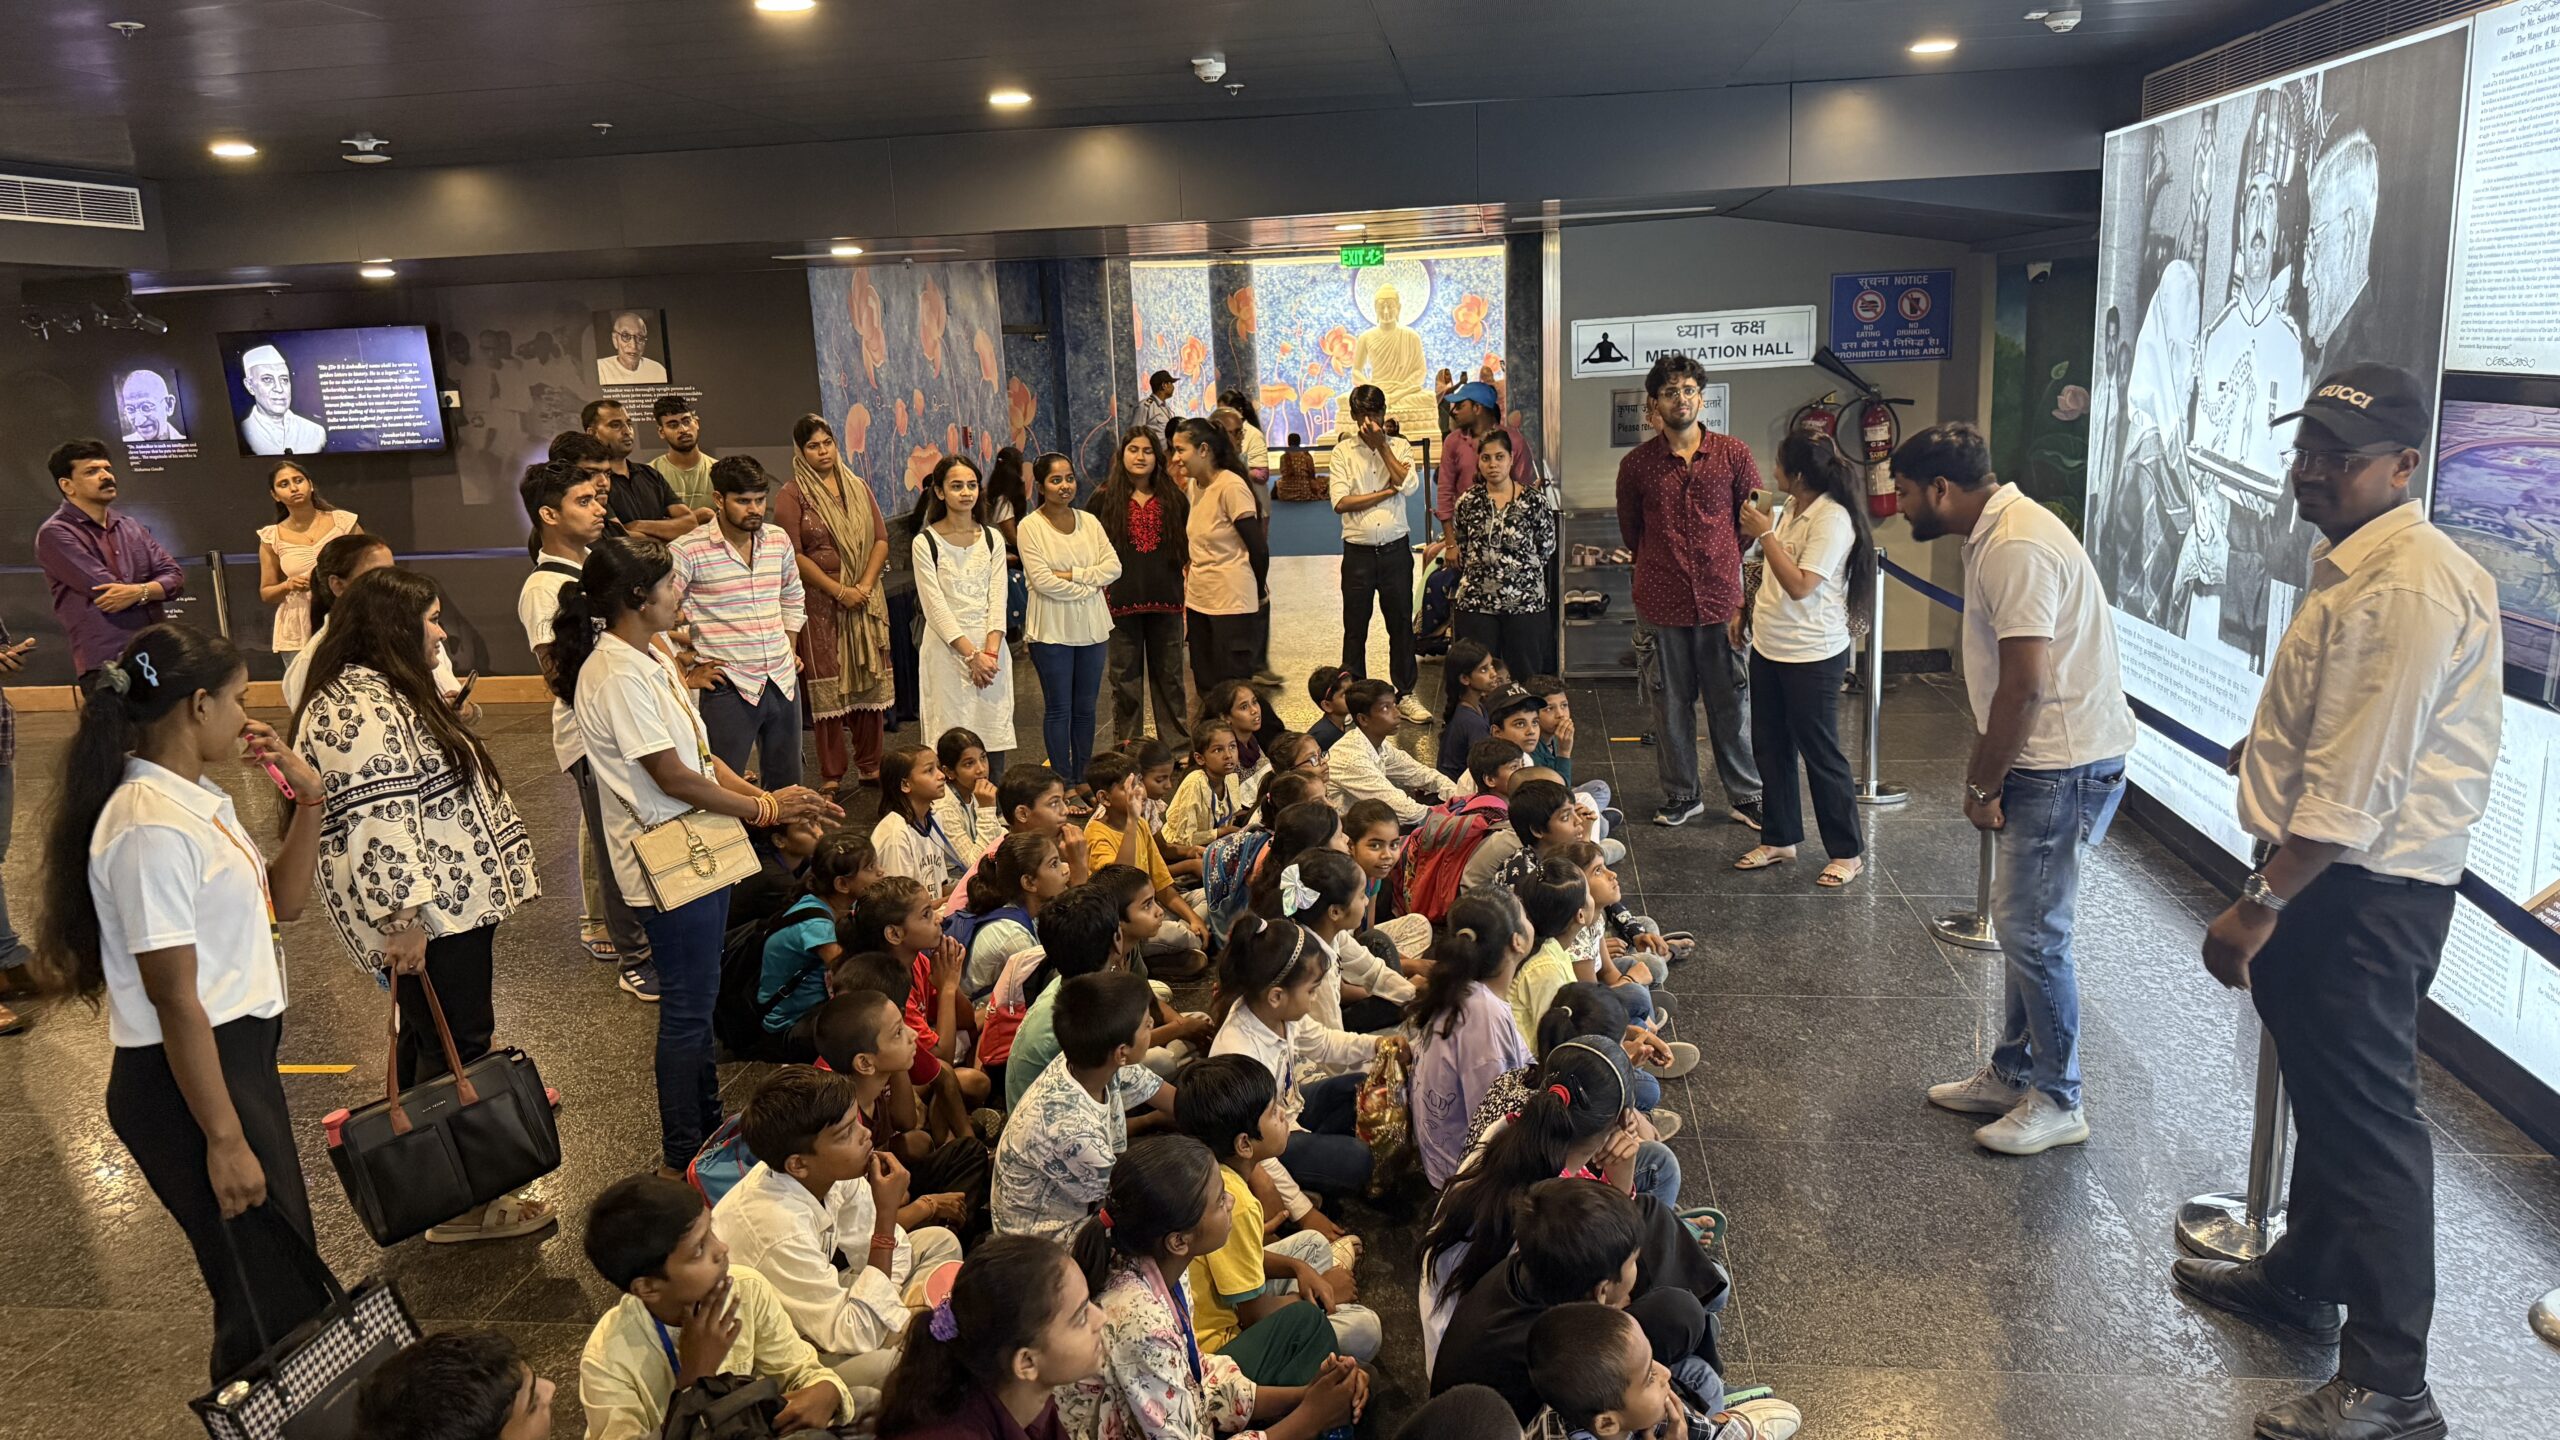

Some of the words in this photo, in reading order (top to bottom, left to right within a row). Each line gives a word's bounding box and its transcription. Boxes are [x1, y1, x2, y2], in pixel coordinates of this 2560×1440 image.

[1342, 250, 1365, 265] EXIT
[1857, 277, 1889, 289] सूचना
[1894, 275, 1929, 285] NOTICE
[1676, 322, 1719, 339] ध्यान
[1730, 320, 1766, 336] कक्ष
[1856, 330, 1881, 338] EATING
[1645, 345, 1747, 363] MEDITATION
[1752, 342, 1794, 356] HALL
[1840, 341, 1857, 350] इस
[1835, 350, 1886, 359] PROHIBITED
[1900, 348, 1920, 356] THIS
[1922, 347, 1946, 355] AREA
[2318, 384, 2375, 409] GUCCI
[1618, 423, 1639, 432] Please
[1706, 418, 1721, 427] here
